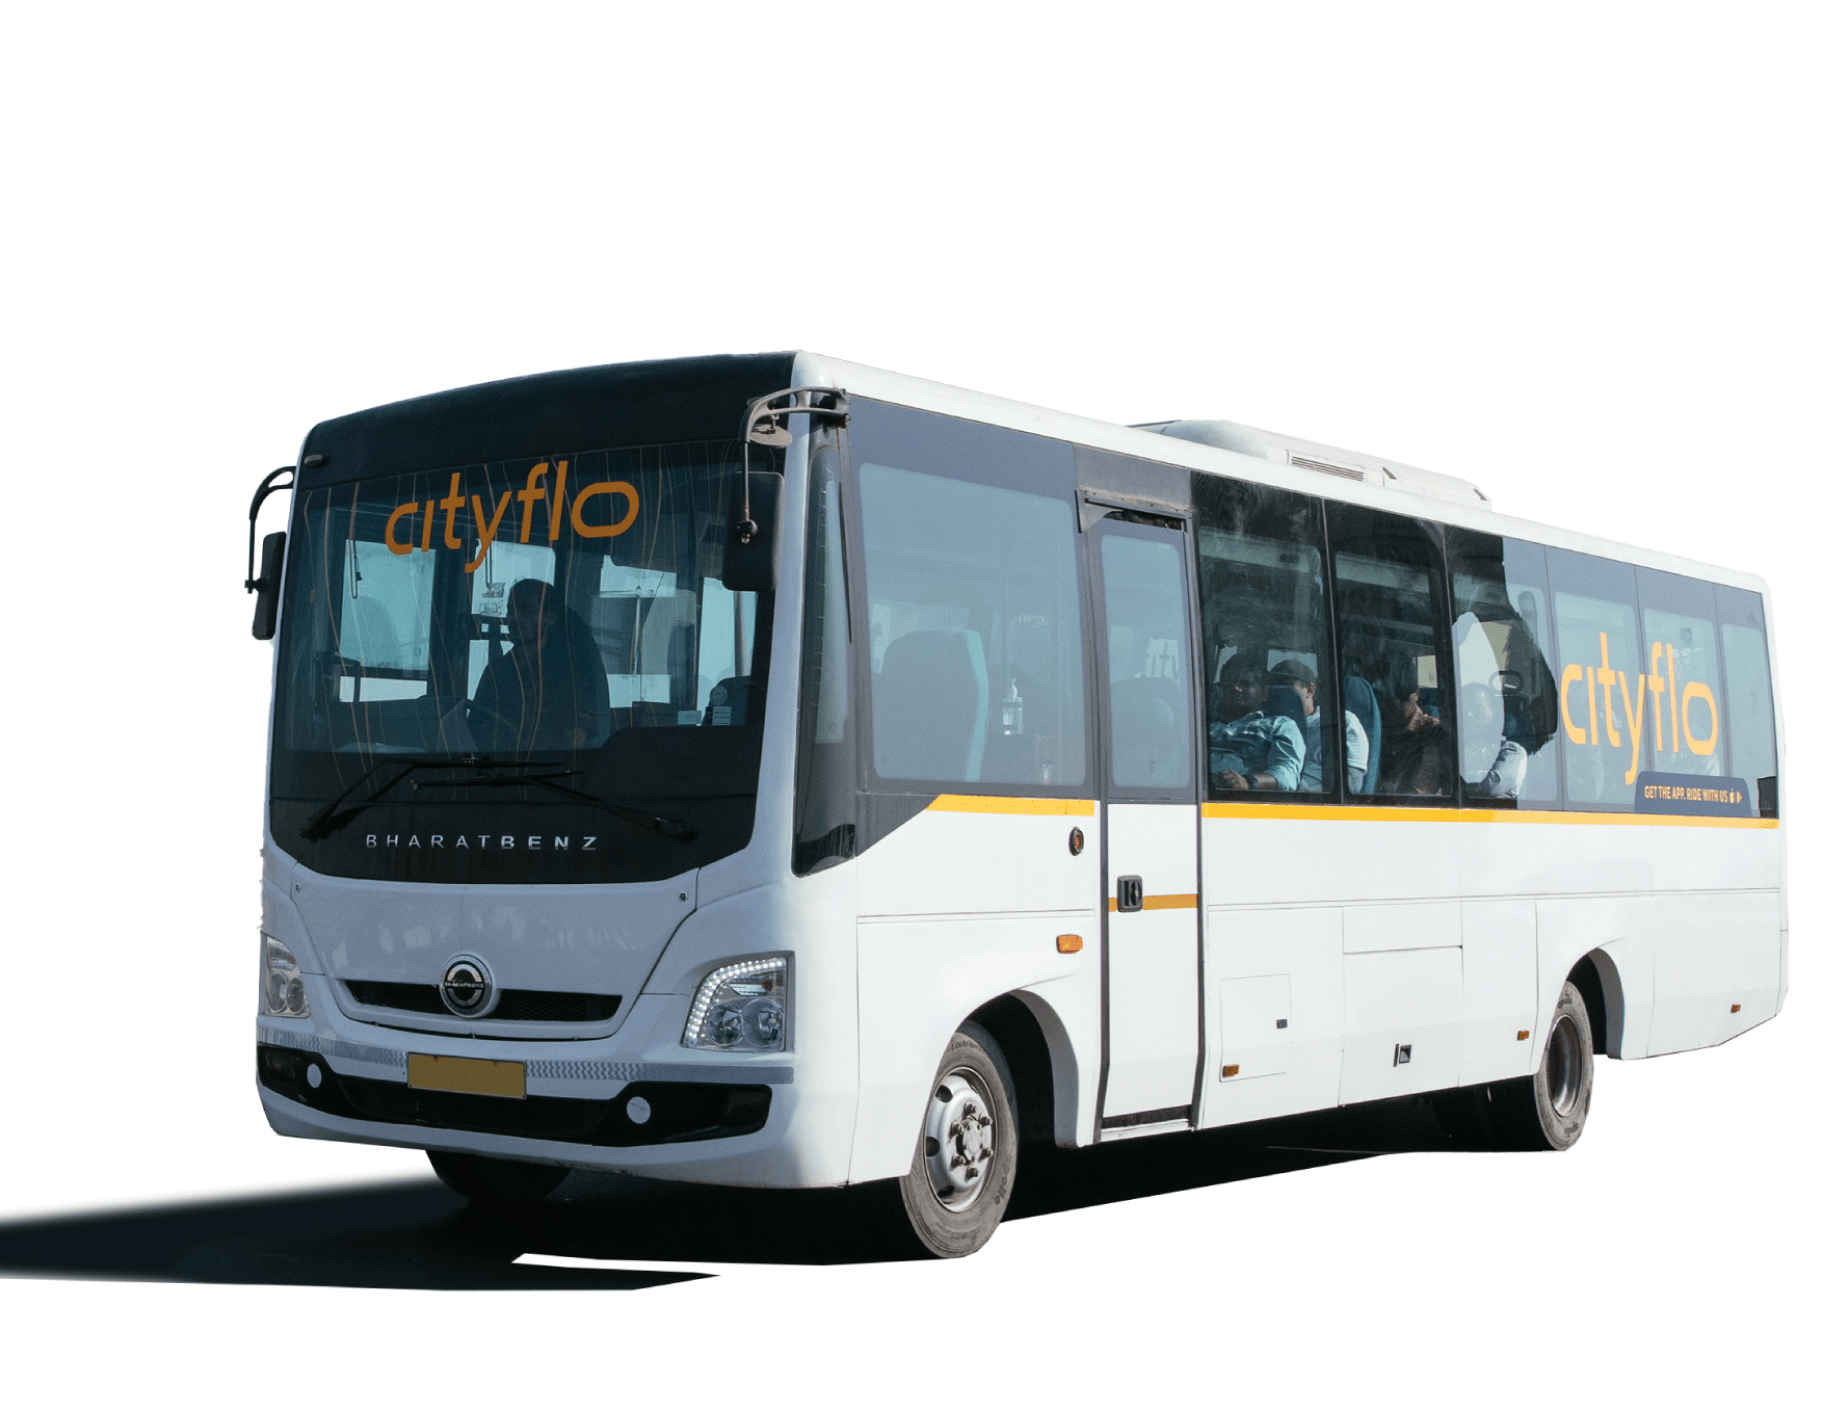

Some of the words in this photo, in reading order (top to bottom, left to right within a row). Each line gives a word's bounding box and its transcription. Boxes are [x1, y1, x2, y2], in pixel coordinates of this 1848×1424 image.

[384, 460, 640, 574] cityflo
[1560, 631, 1719, 786] cityflo
[1644, 786, 1657, 798] GET
[1658, 786, 1671, 799] THE
[1672, 787, 1686, 800] APP.
[1686, 787, 1702, 801] RIDE
[1702, 789, 1718, 802] WITH
[1719, 790, 1729, 803] US
[366, 834, 598, 851] BHARATBENZ
